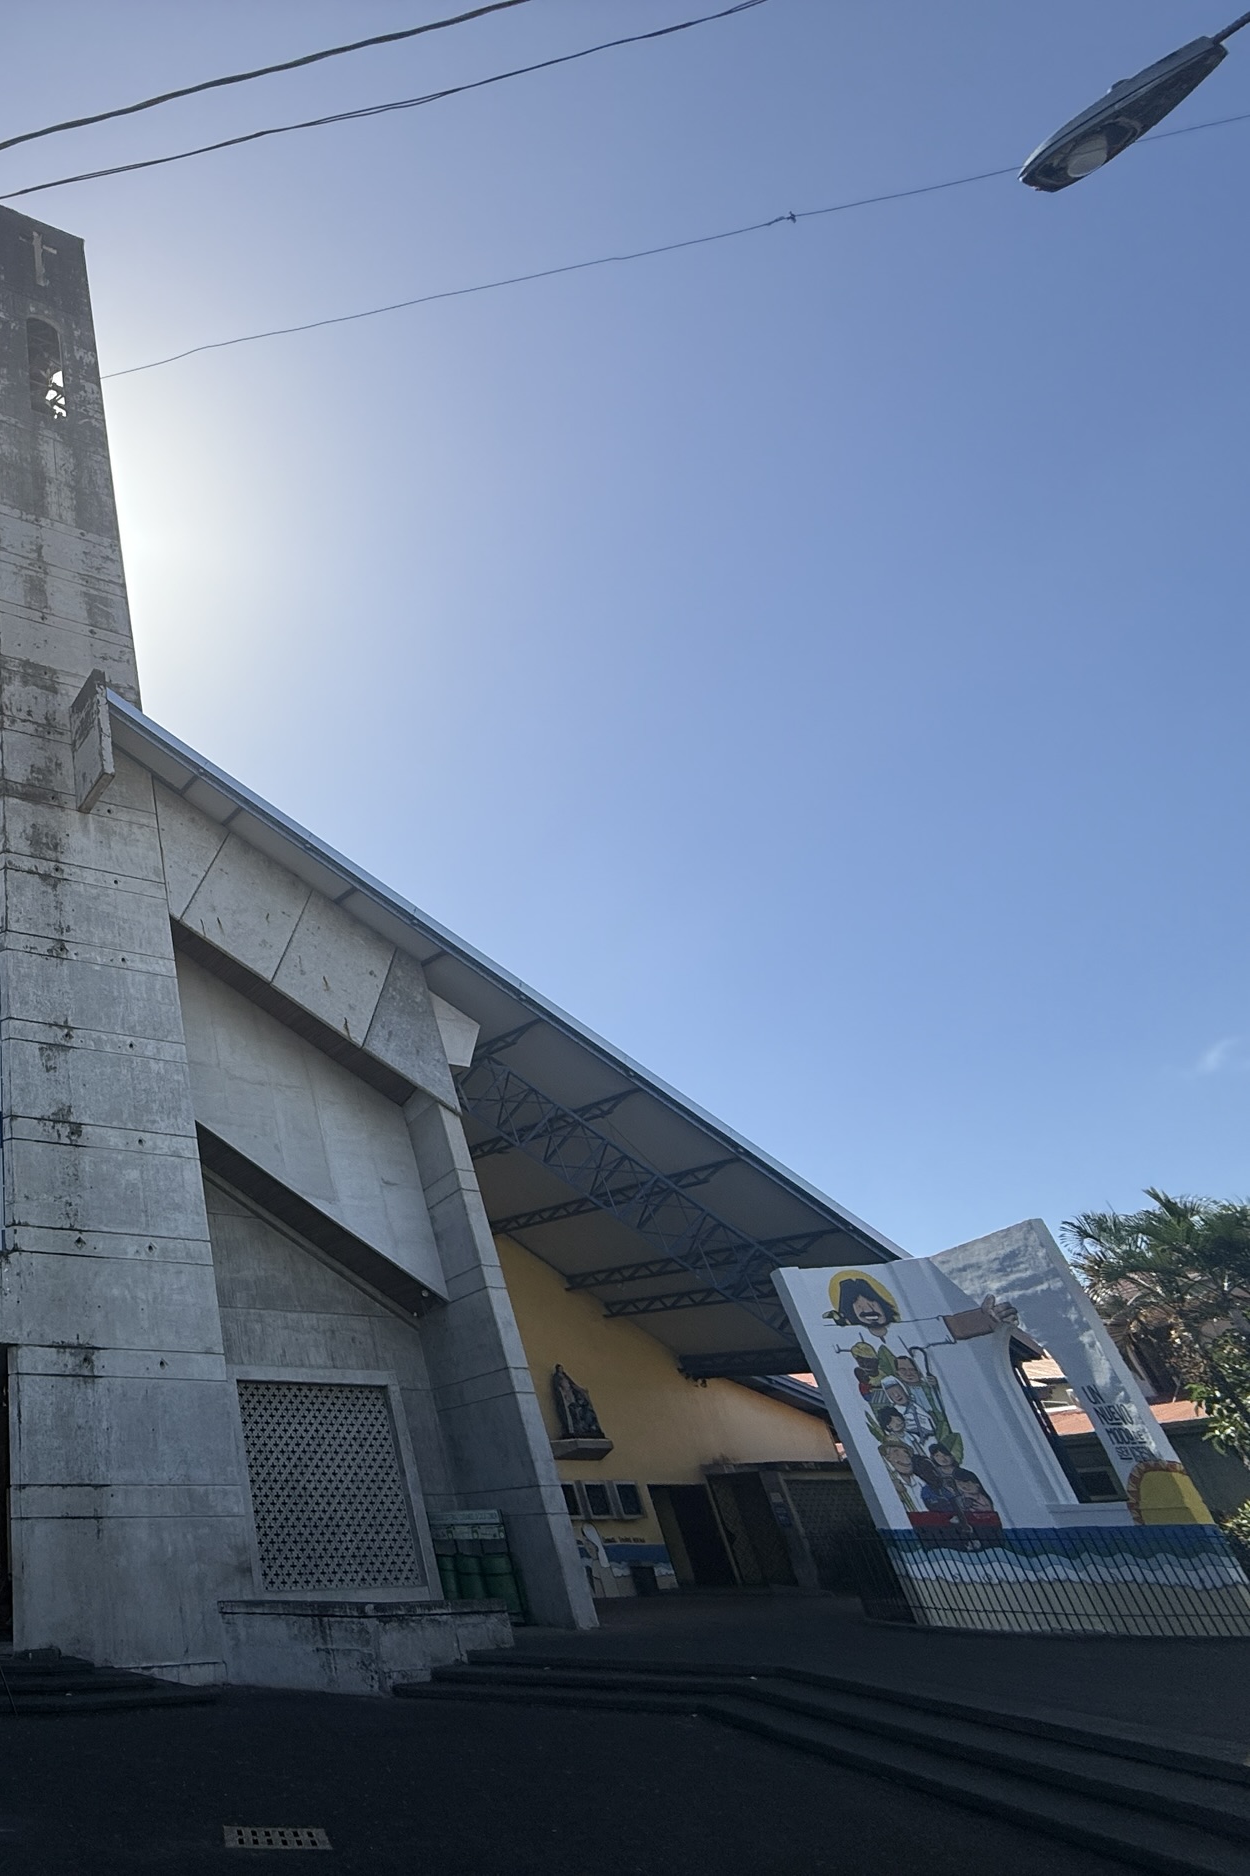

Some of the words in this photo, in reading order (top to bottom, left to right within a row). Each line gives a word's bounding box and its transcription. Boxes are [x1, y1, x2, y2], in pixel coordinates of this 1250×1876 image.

[1082, 1384, 1105, 1405] UN
[1093, 1404, 1134, 1425] NUEVO
[1105, 1427, 1134, 1445] MODO
